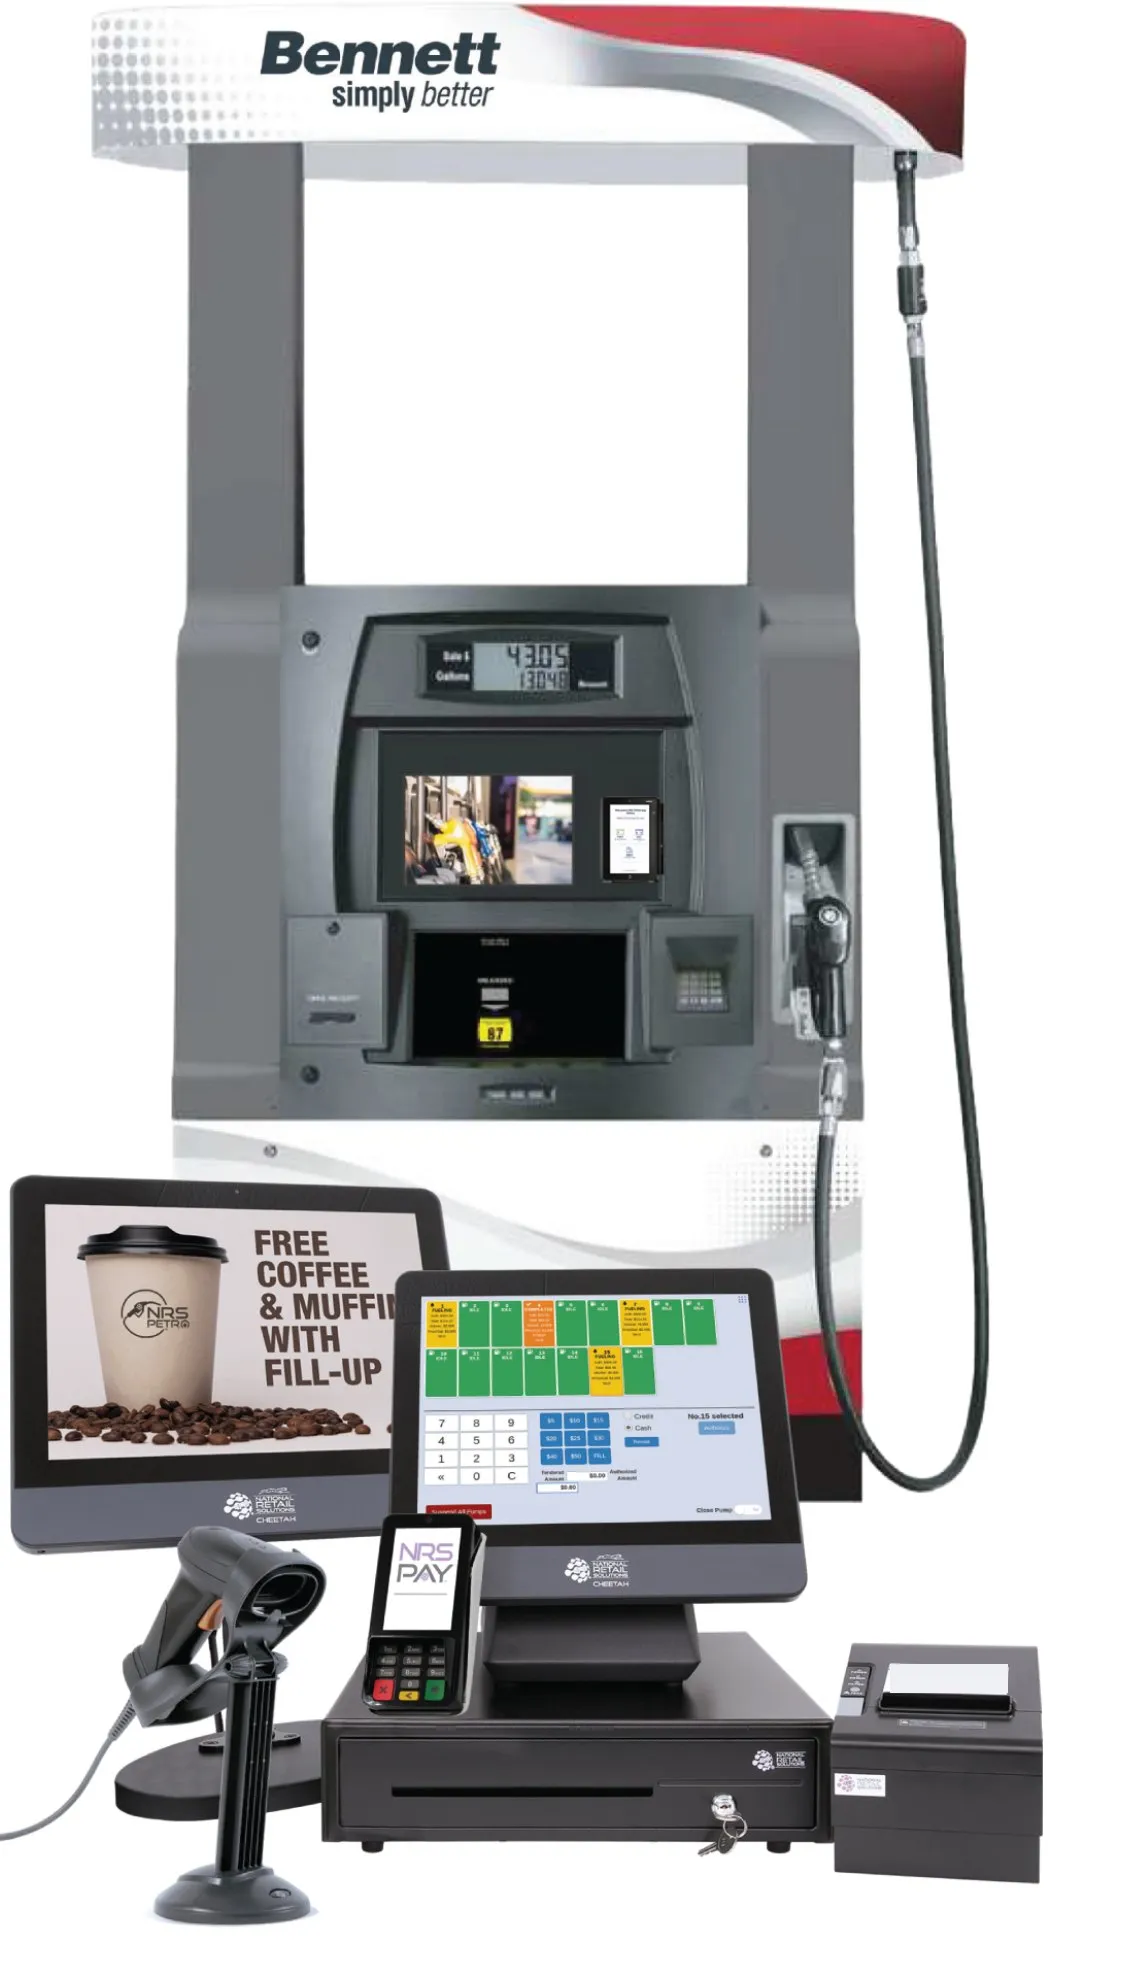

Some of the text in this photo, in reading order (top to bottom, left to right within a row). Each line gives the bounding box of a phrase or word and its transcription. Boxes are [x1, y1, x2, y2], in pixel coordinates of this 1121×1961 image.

[260, 31, 501, 75] Bennett
[332, 81, 495, 113] simply better
[487, 1027, 504, 1041] 87
[254, 1230, 329, 1256] FREE
[257, 1261, 370, 1288] COFFEE
[260, 1293, 283, 1320] &
[147, 1306, 189, 1319] NRS
[260, 1325, 341, 1353] WITH
[265, 1358, 382, 1387] FILL-UP
[711, 1412, 744, 1420] selected
[438, 1419, 445, 1428] 7
[473, 1419, 480, 1428] 8
[507, 1418, 515, 1427] 9
[437, 1436, 445, 1445] 4
[473, 1436, 480, 1445] 5
[508, 1436, 515, 1444] 6
[438, 1454, 444, 1463] 1
[473, 1454, 480, 1463] 2
[508, 1453, 515, 1462] 3
[473, 1472, 480, 1480] 0
[507, 1471, 516, 1480] C
[399, 1542, 453, 1561] NRS
[396, 1563, 454, 1583] PAY
